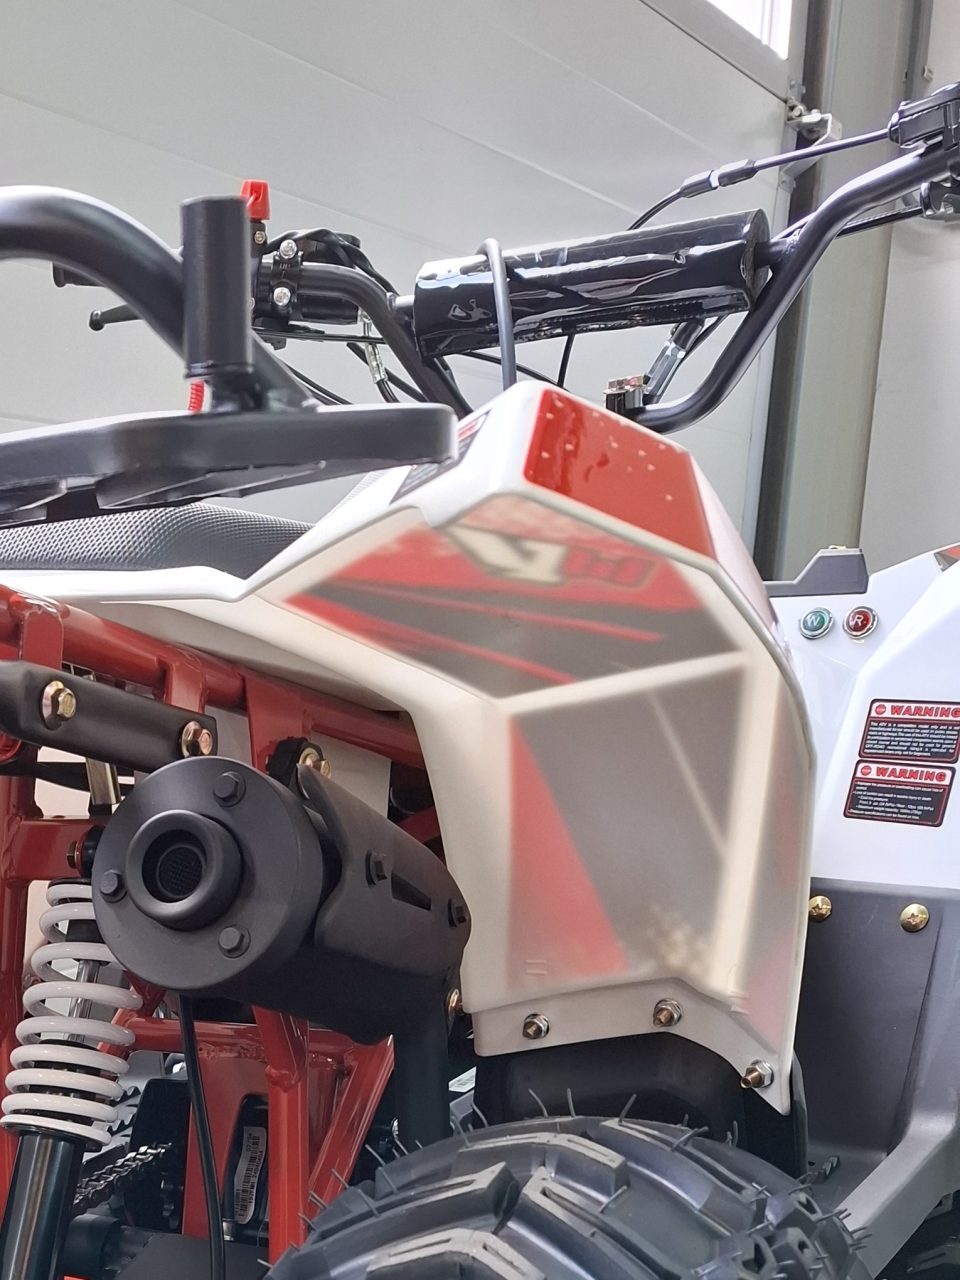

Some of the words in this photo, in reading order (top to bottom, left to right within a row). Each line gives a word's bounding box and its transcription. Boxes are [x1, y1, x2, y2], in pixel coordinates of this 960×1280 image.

[853, 614, 864, 627] R
[890, 704, 960, 718] WARNING
[876, 766, 947, 783] WARNING
